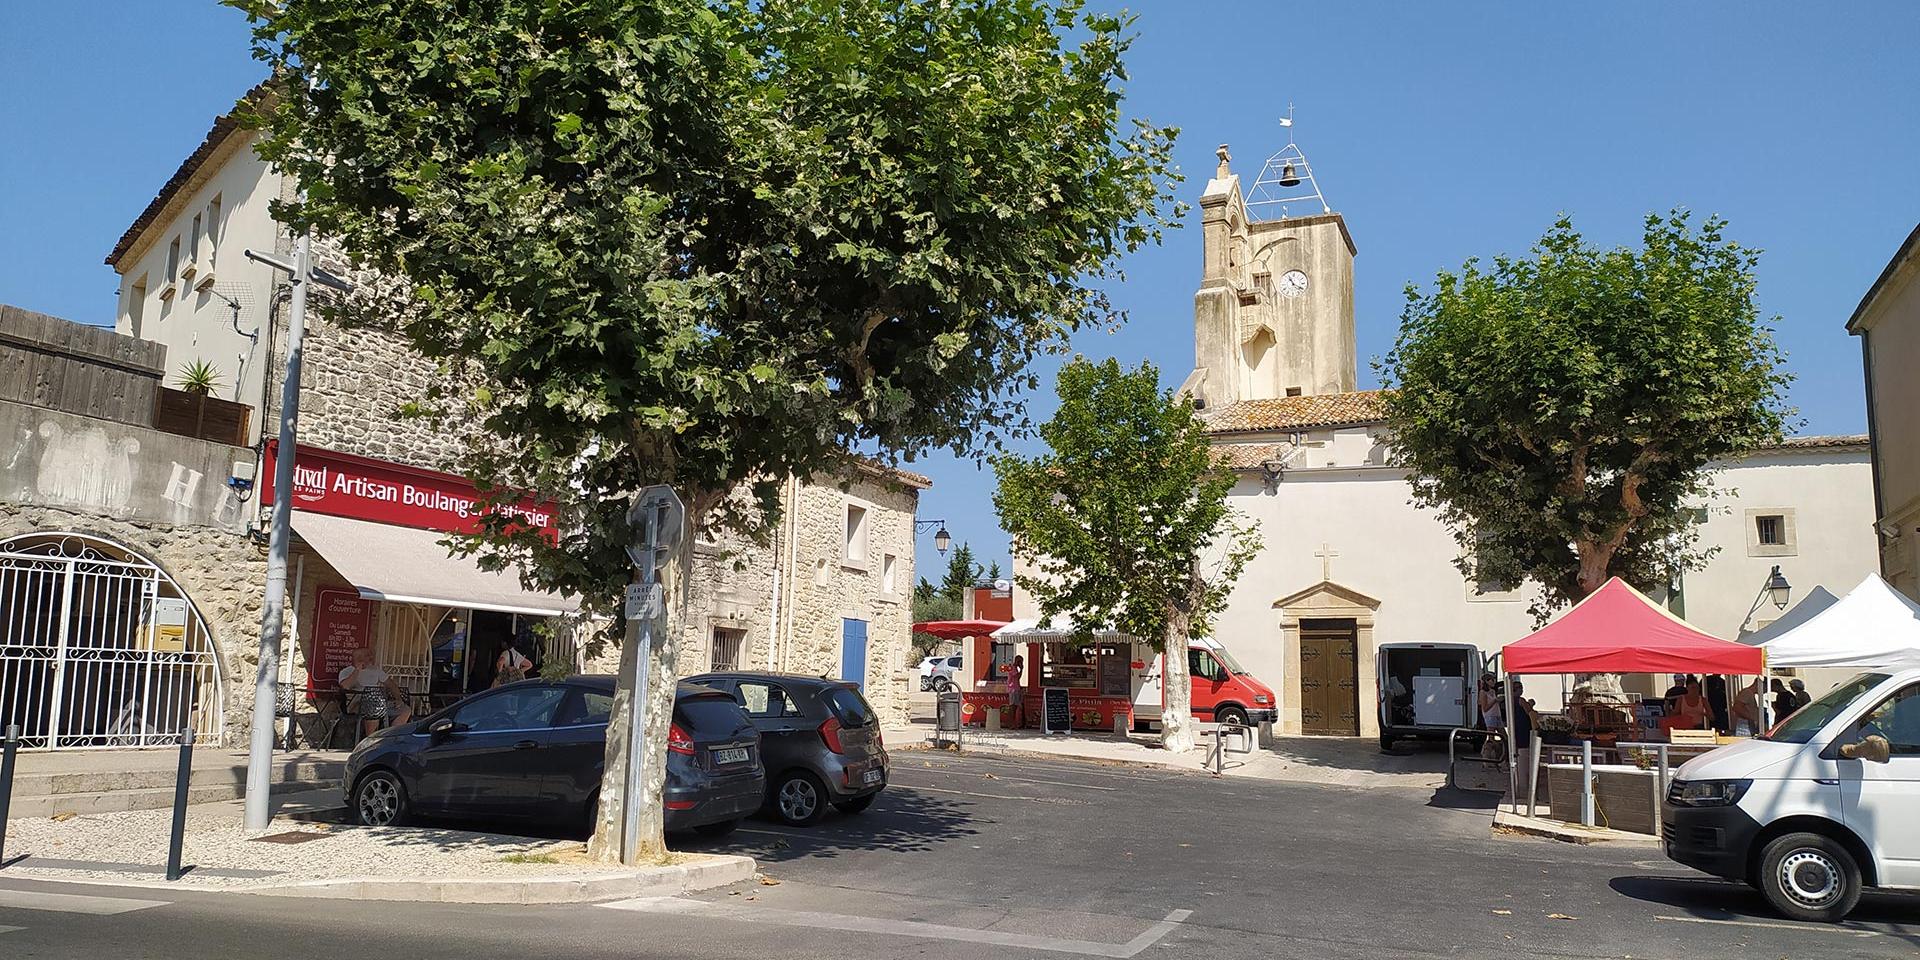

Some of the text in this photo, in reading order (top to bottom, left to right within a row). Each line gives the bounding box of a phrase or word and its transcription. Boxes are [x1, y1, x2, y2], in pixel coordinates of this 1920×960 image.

[305, 485, 326, 495] PAINS
[333, 473, 397, 502] Artisan
[403, 484, 482, 518] Boulange
[146, 582, 151, 591] 2
[333, 597, 358, 606] Horaires
[328, 604, 361, 613] d'ouverture
